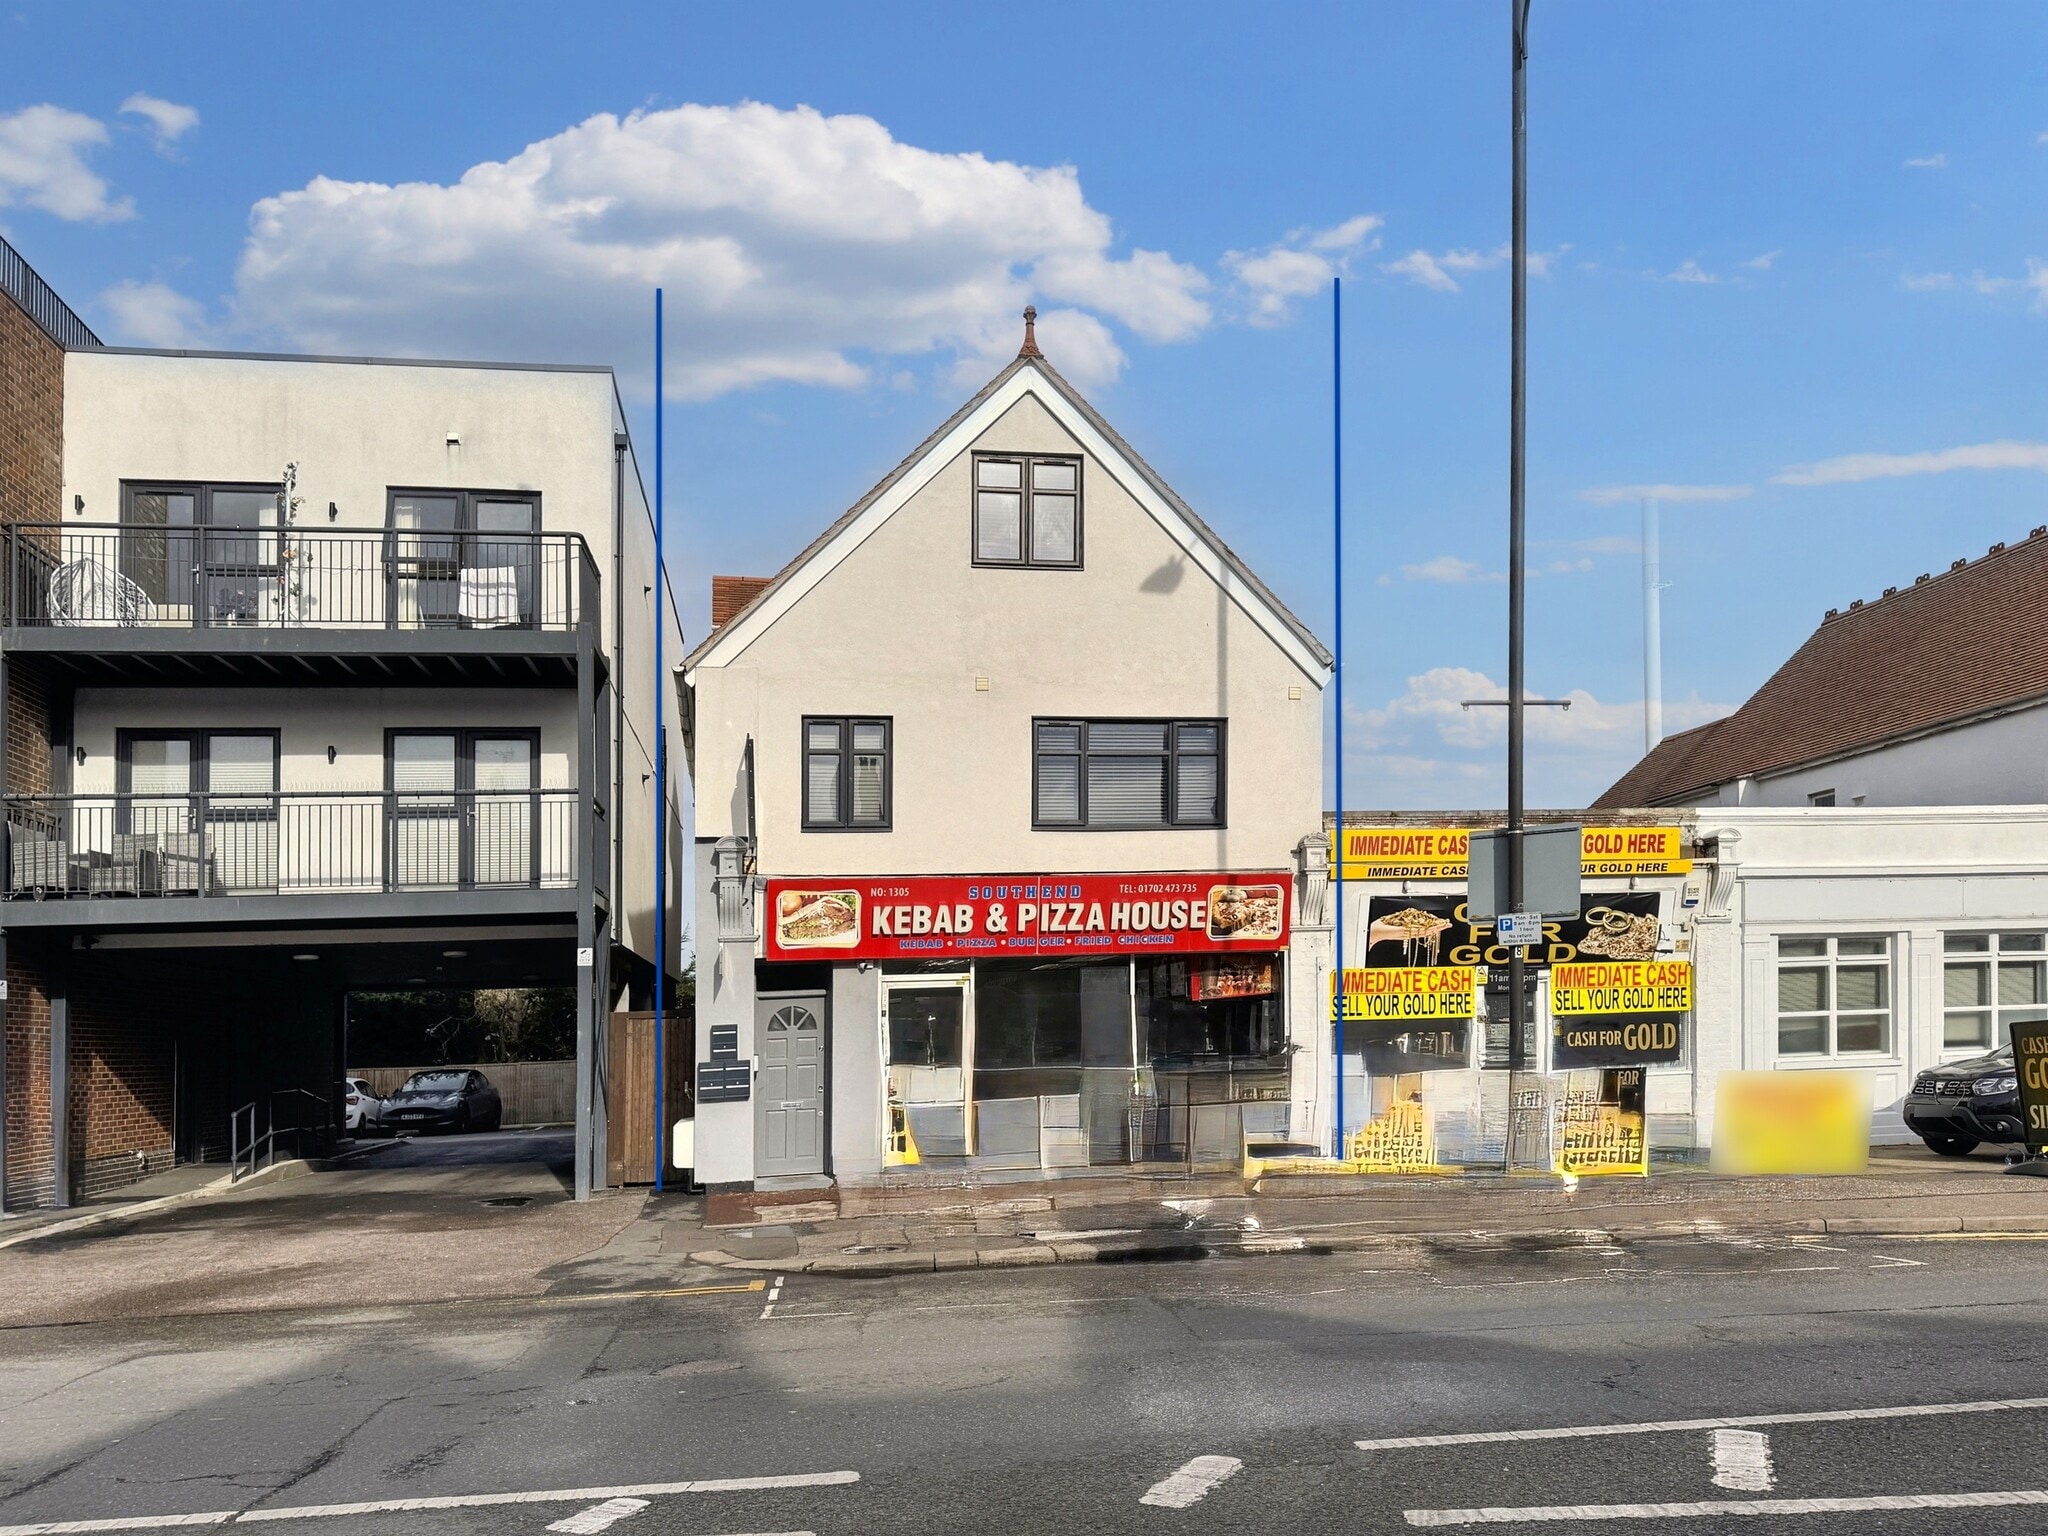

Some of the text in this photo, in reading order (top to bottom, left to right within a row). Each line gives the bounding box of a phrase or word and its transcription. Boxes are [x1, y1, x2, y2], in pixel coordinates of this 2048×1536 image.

[1350, 833, 1666, 856] IMMEDIATE CAS GOLD HERE
[1367, 862, 1668, 877] IMMEDIATE CAS UR GOLD HERE
[870, 887, 910, 897] NO: 1305
[968, 885, 1081, 899] SOUTHEND
[1119, 883, 1197, 893] TEL: 01702 473 735
[872, 900, 1207, 936] KEBAB & PIZZA HOUSE
[1503, 919, 1511, 930] P
[900, 938, 943, 949] KEBAB
[956, 937, 996, 948] PIZZA
[1074, 935, 1112, 946] FRIED
[1117, 934, 1174, 945] CHICKEN
[1469, 922, 1562, 944] FR
[1449, 944, 1577, 965] GOLD
[1332, 969, 1471, 993] IMMEDIATE CASH
[1523, 974, 1536, 983] pm
[1555, 963, 1687, 988] IMMEDIATE CASH
[1332, 993, 1471, 1016] SELL YOUR GOLD HERE
[1555, 986, 1687, 1011] SELL YOUR GOLD HERE
[1567, 1022, 1676, 1051] CASH FOR GOLD
[1618, 1070, 1639, 1085] FOR
